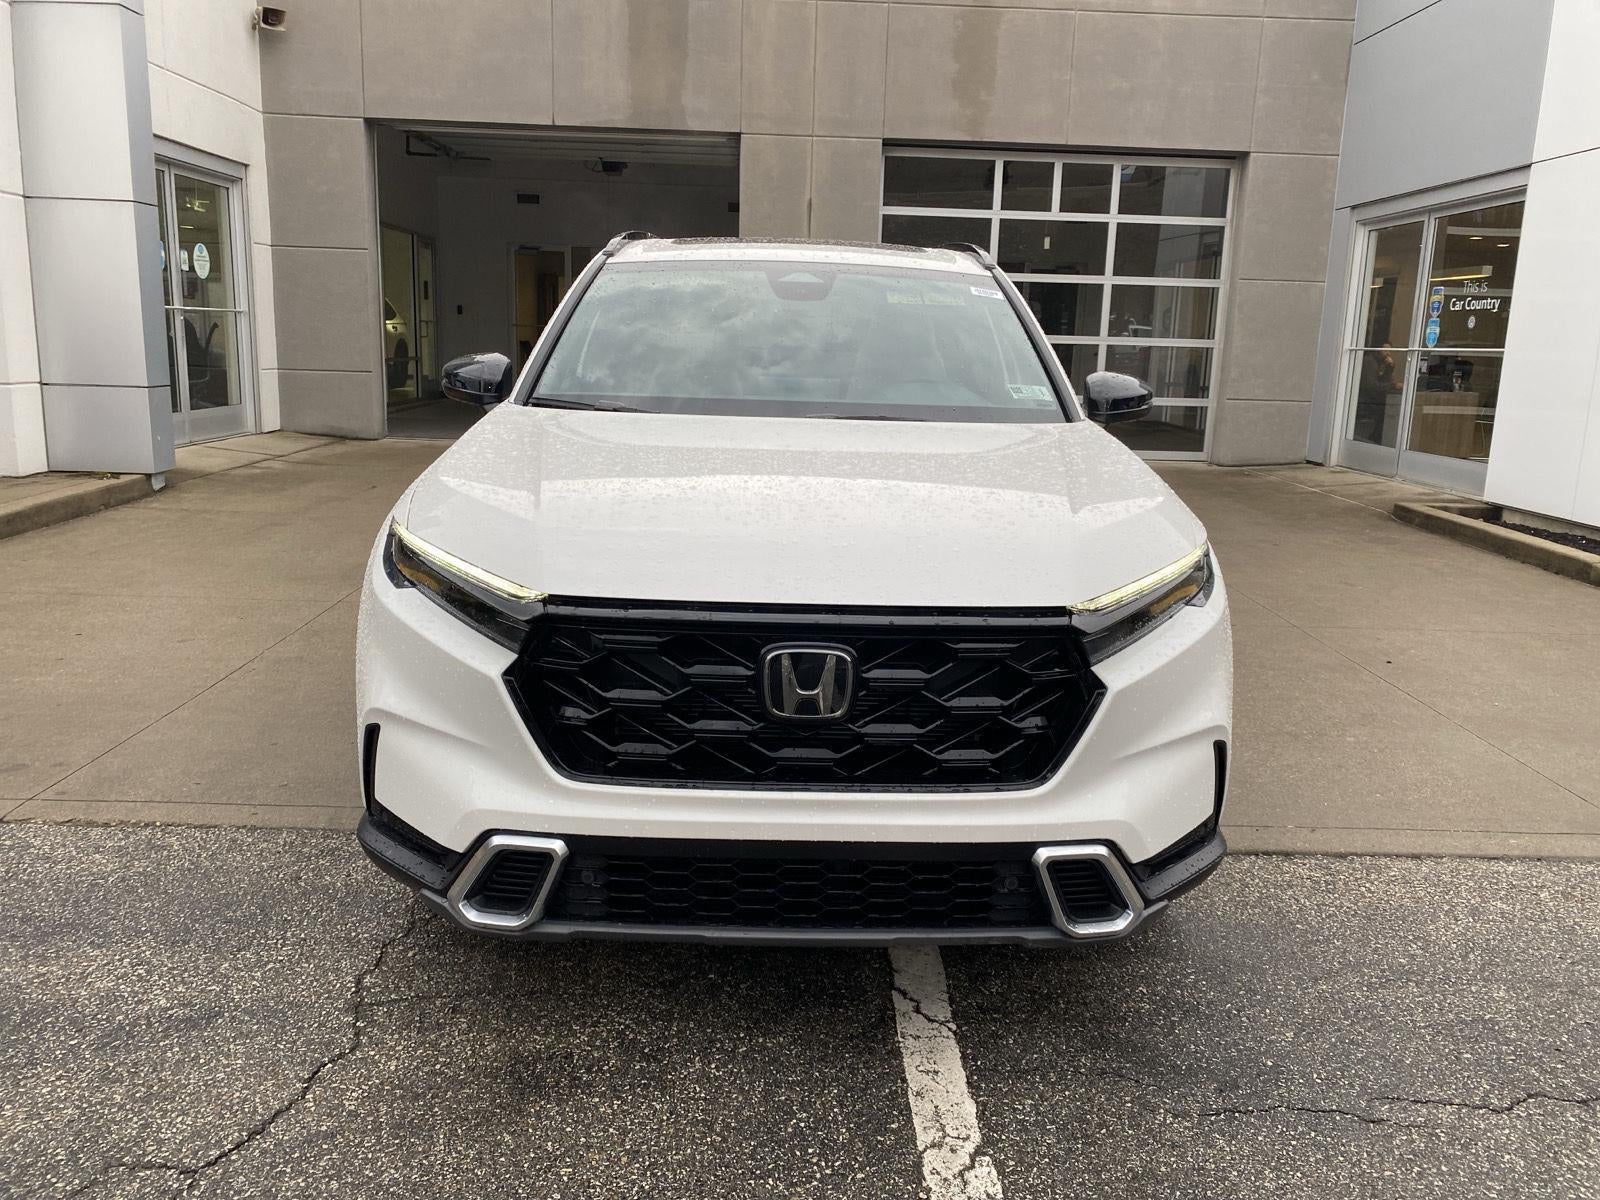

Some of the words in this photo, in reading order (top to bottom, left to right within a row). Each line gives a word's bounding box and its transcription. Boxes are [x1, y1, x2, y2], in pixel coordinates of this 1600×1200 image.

[1463, 280, 1479, 293] This
[1481, 279, 1488, 292] is
[1450, 298, 1464, 311] Car
[1465, 297, 1501, 312] Country
